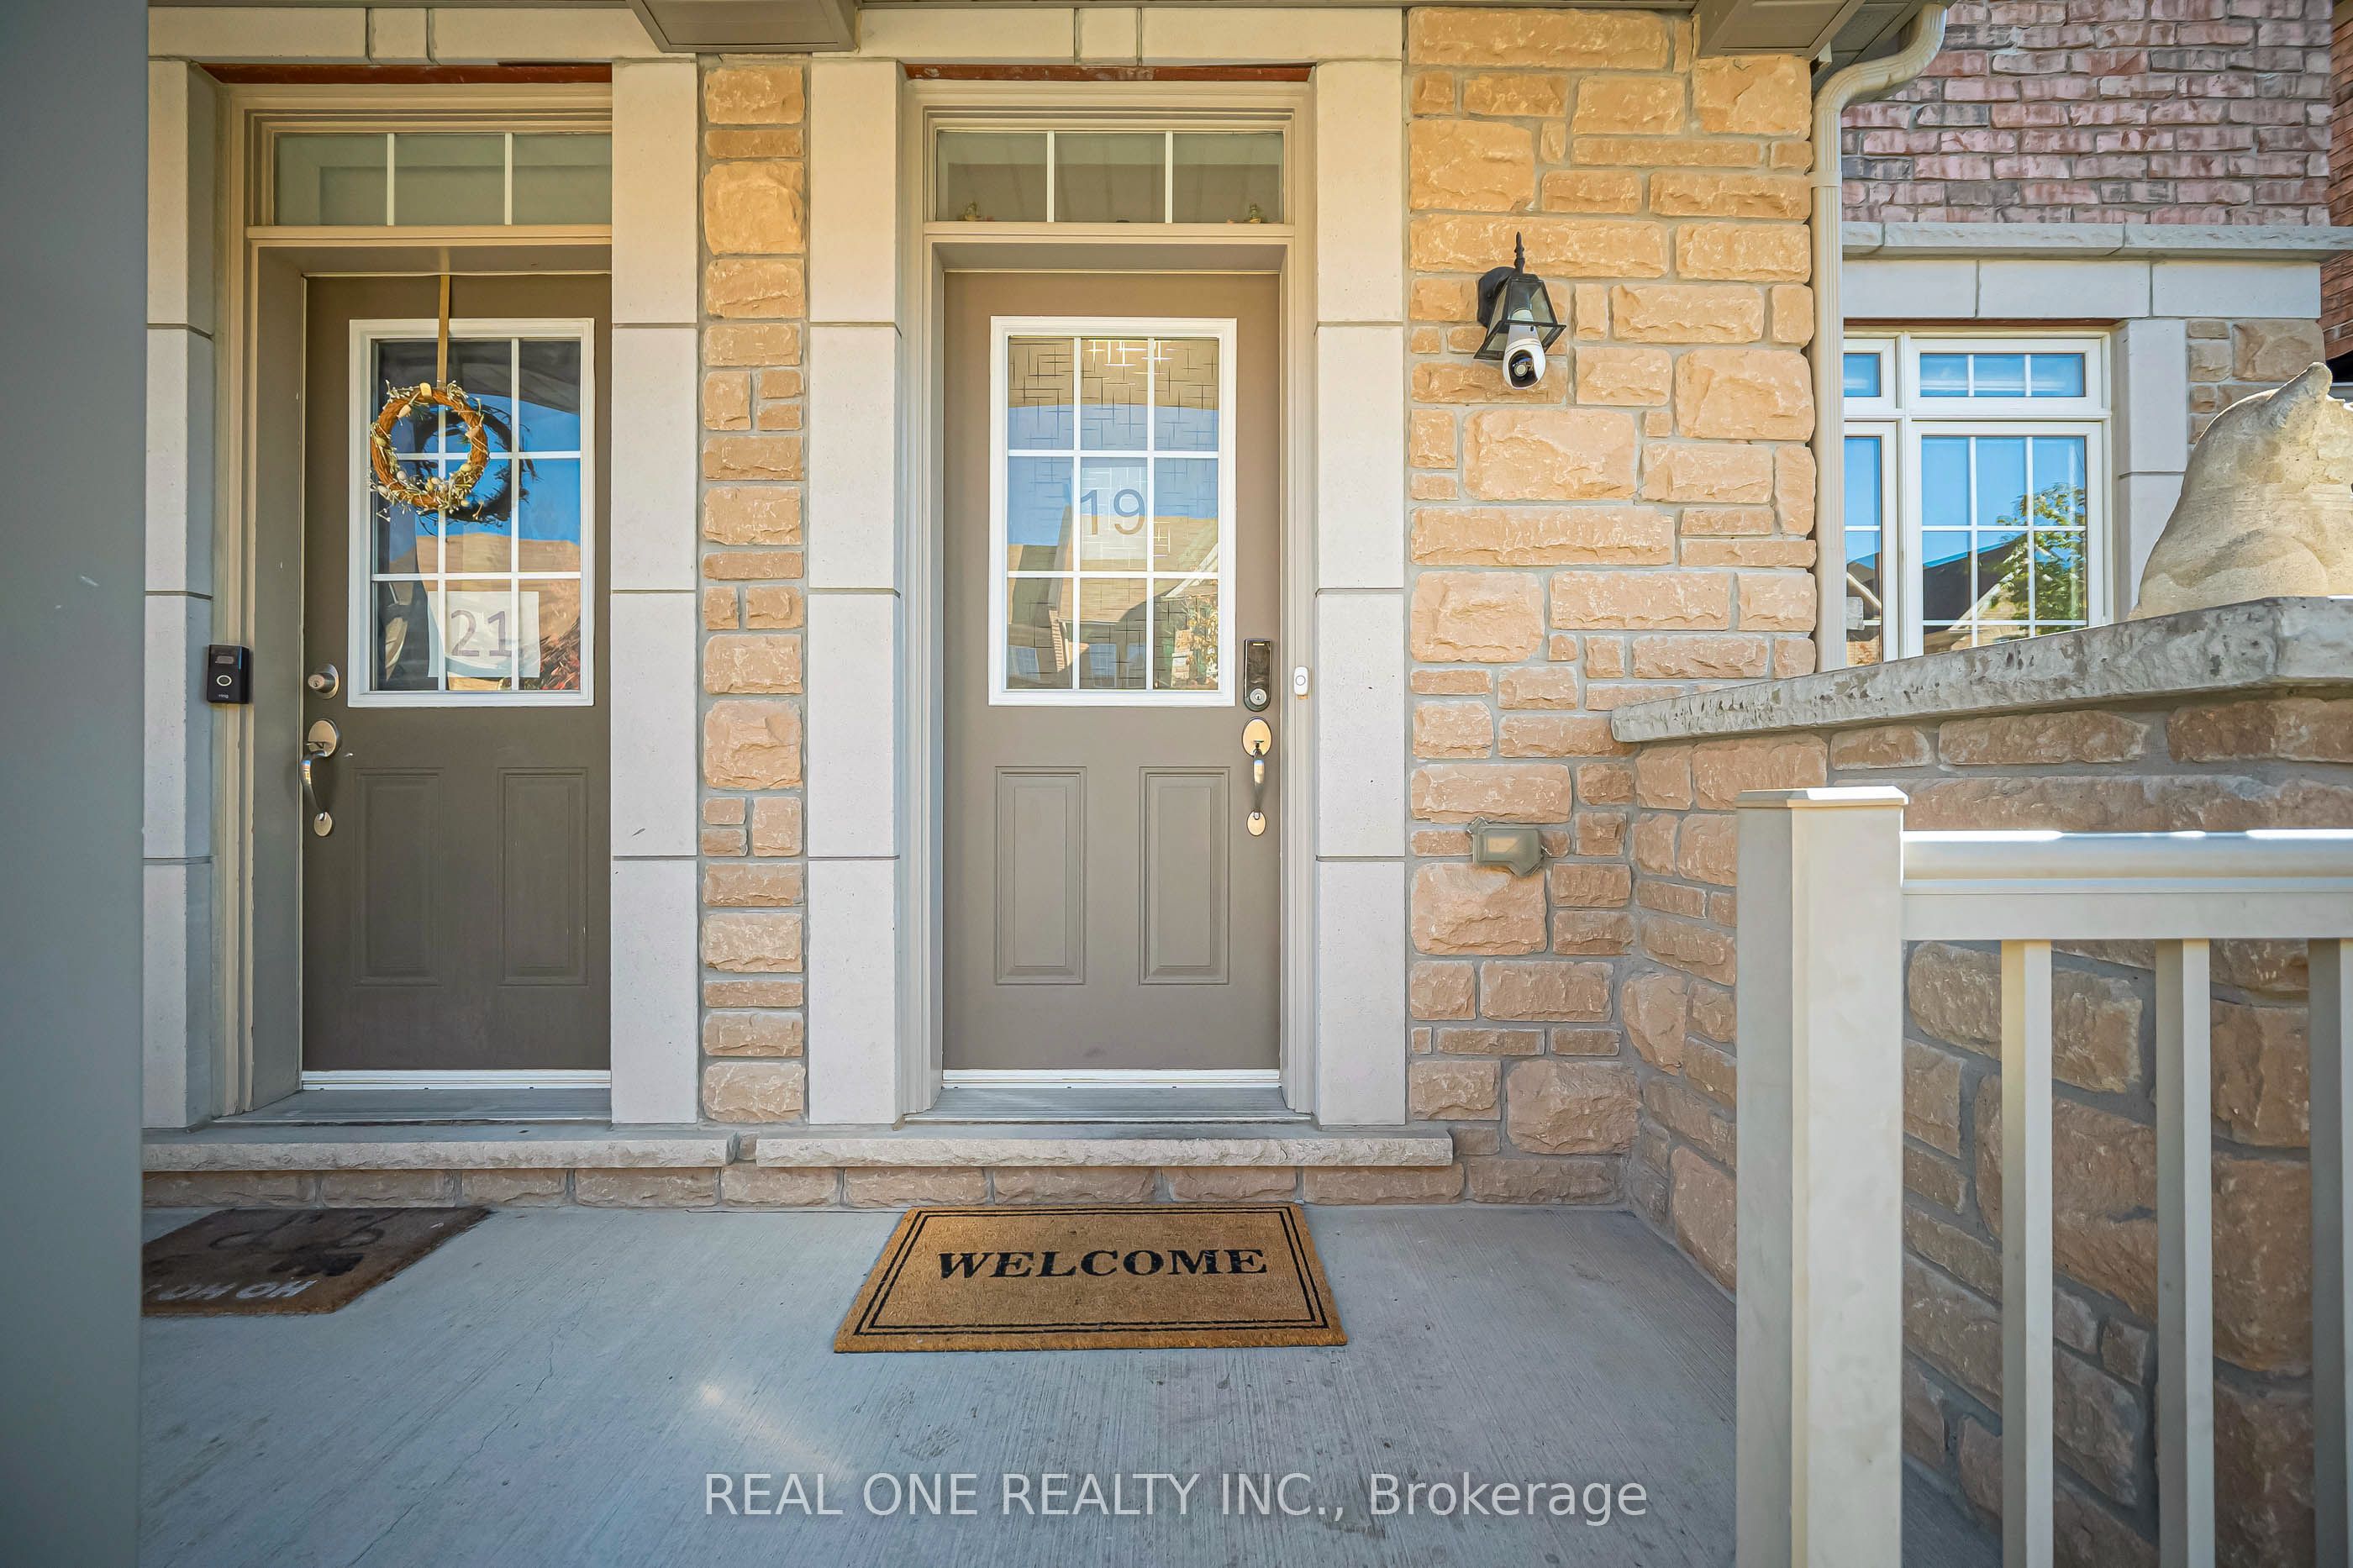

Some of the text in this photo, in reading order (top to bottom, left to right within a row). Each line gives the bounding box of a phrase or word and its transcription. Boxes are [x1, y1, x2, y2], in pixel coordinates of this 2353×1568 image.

[1081, 488, 1145, 535] 19
[451, 609, 514, 657] 21
[939, 1249, 1267, 1279] WELCOME
